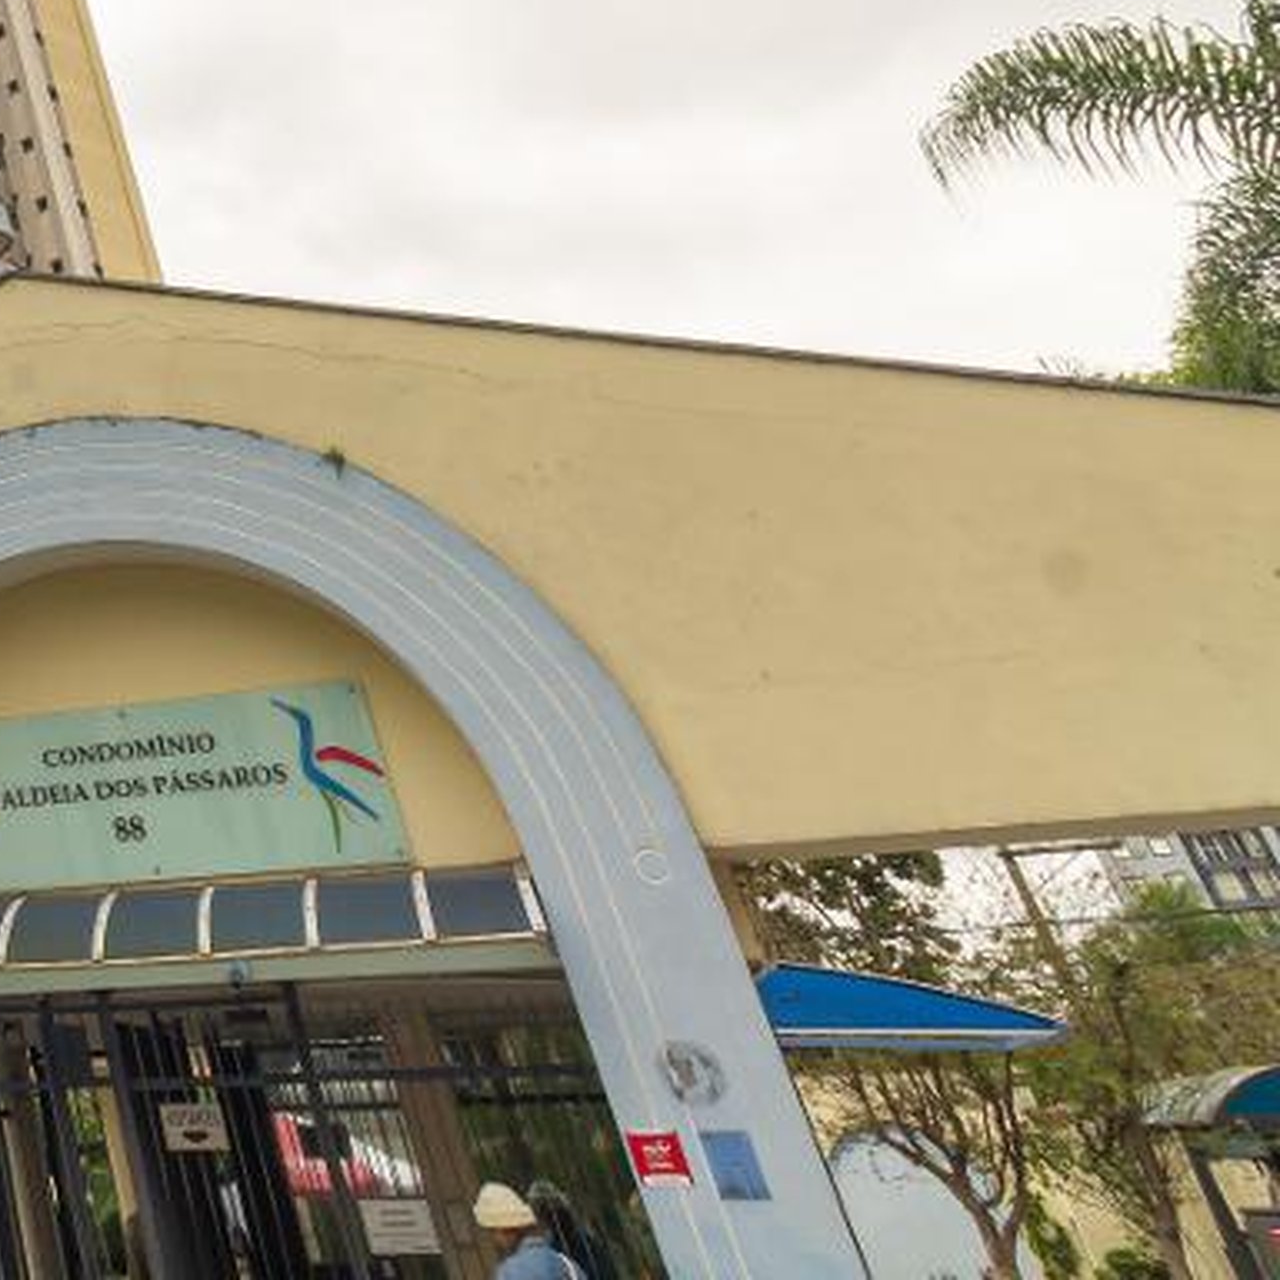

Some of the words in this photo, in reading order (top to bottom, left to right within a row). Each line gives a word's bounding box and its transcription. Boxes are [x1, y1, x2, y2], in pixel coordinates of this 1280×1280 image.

[42, 732, 216, 768] CONDOMÍNIO
[1, 783, 90, 810] ALDEIA
[95, 778, 148, 801] DOS
[152, 763, 289, 795] PÁSSAROS
[112, 814, 147, 843] 88
